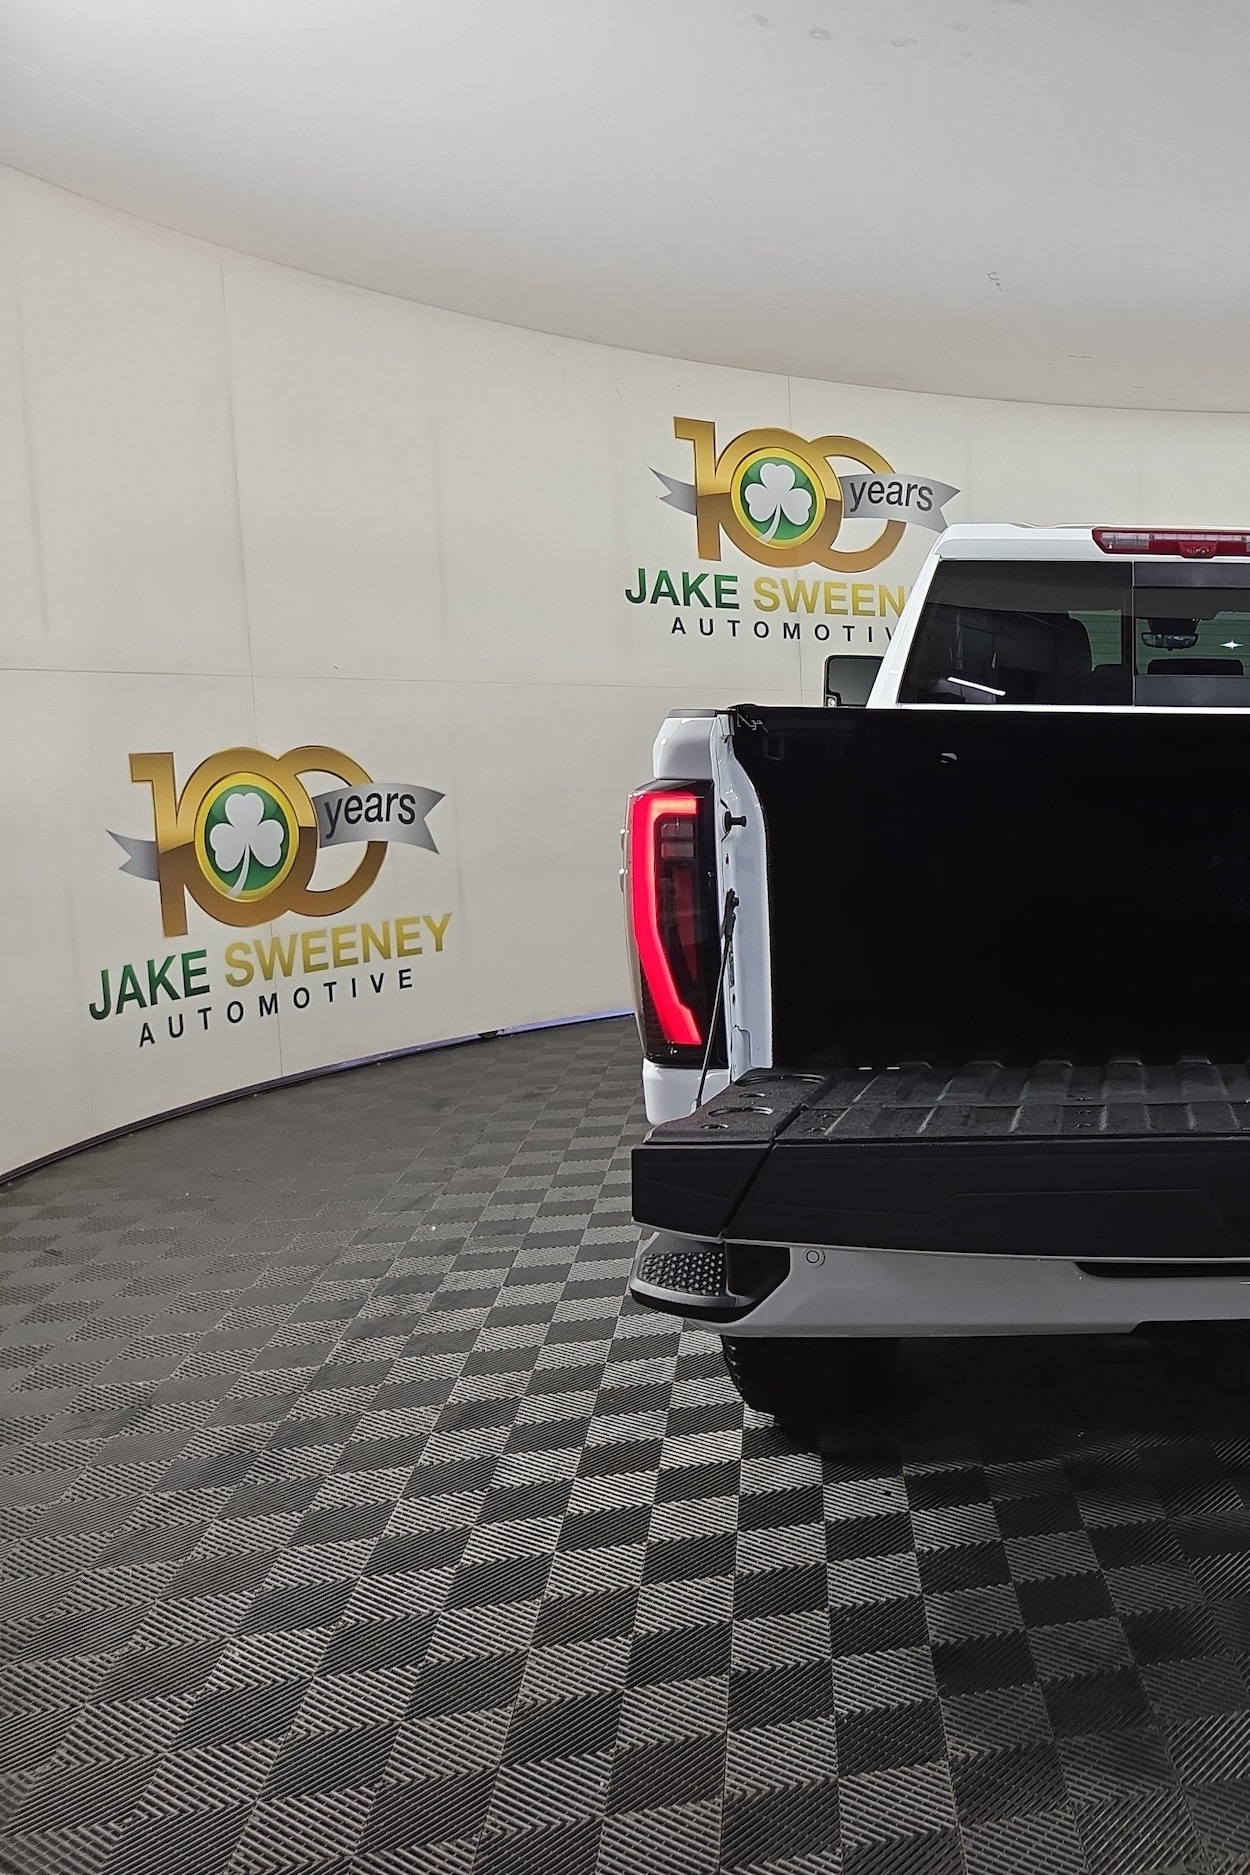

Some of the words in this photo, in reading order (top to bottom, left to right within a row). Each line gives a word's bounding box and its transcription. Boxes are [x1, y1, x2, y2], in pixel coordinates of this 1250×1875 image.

[673, 416, 907, 573] 100
[849, 480, 934, 512] years
[625, 567, 740, 610] JAKE
[753, 577, 905, 618] SWEEN
[671, 616, 893, 643] AUTOMOTI
[128, 745, 389, 938] 100
[324, 792, 417, 840] years
[89, 949, 211, 1021] JAKE
[224, 912, 453, 988] SWEENEY
[139, 968, 414, 1048] AUTOMOTIVE
